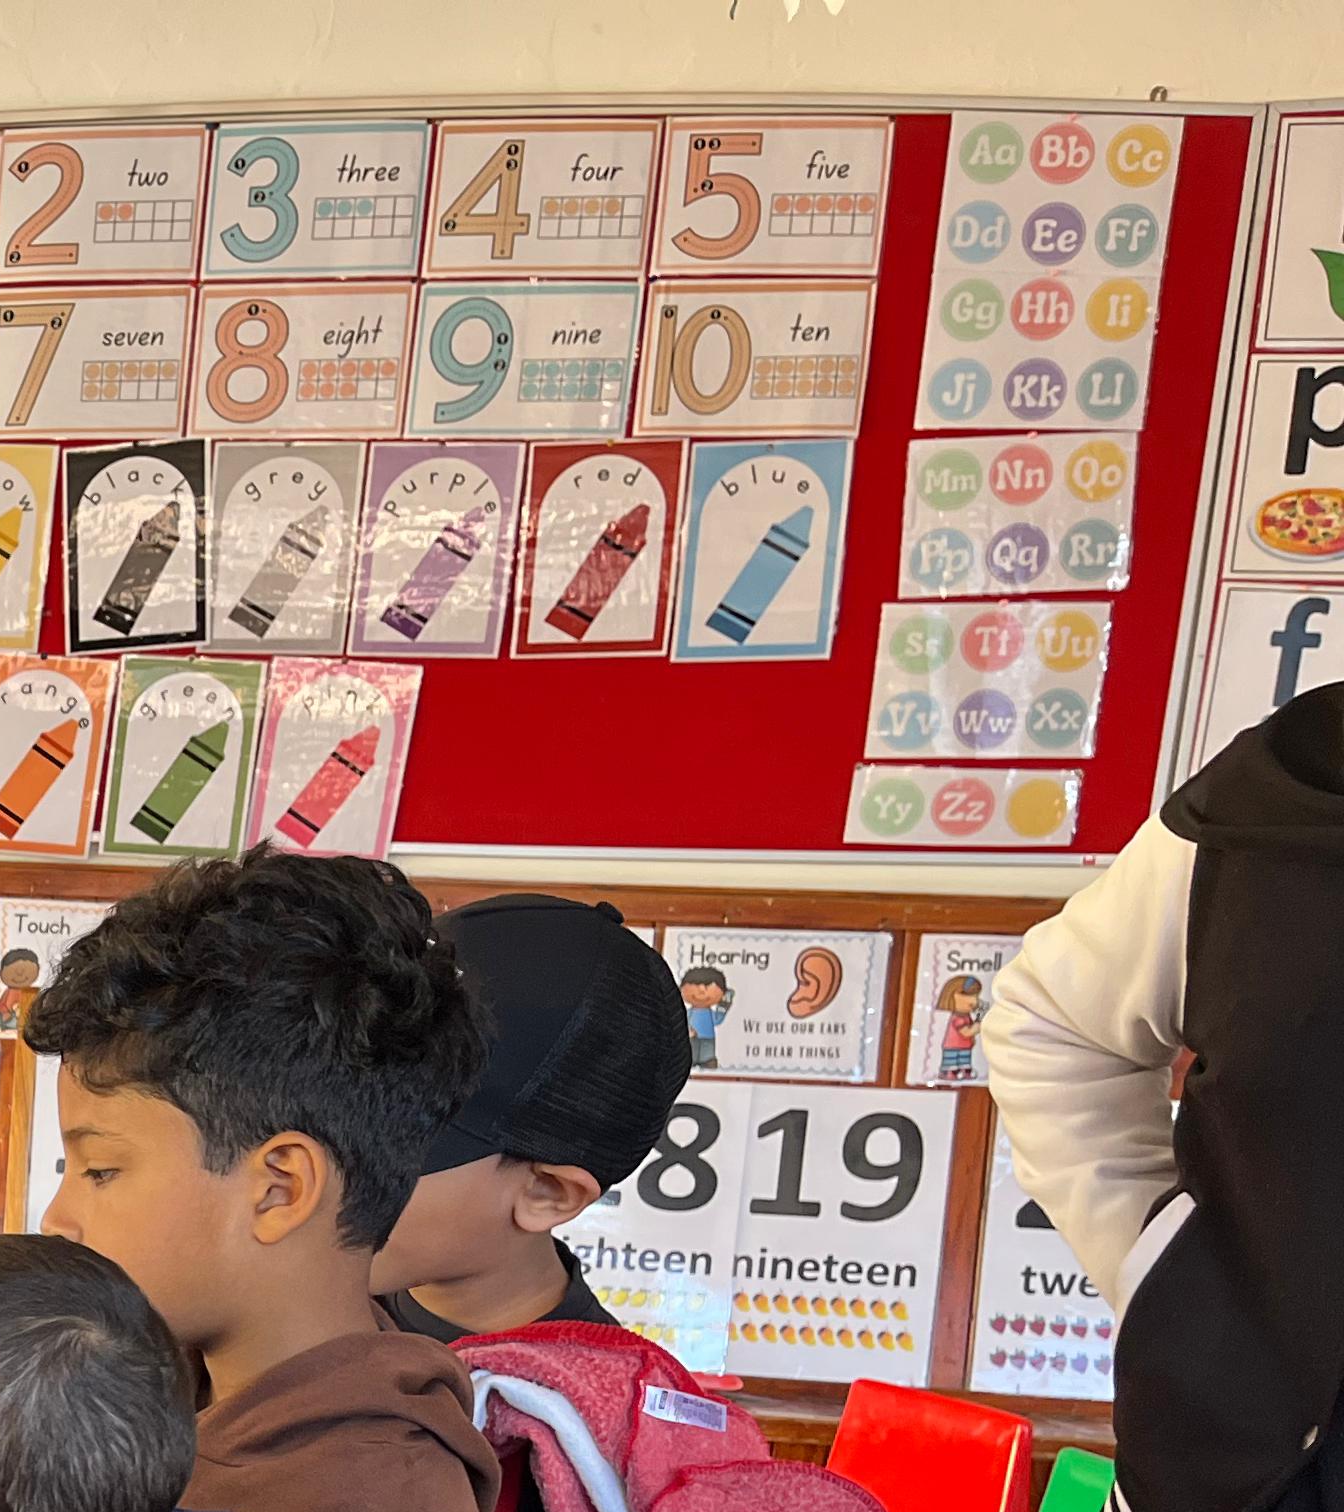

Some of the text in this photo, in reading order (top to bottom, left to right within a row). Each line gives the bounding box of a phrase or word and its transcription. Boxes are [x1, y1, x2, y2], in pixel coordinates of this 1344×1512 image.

[336, 154, 401, 184] three
[570, 153, 624, 184] four
[805, 148, 850, 181] five
[969, 134, 1164, 173] Aa Bb Cc
[128, 158, 169, 188] two
[5, 142, 84, 267] 2
[220, 137, 300, 263] 3
[439, 140, 531, 260] 4
[672, 133, 763, 261] 5
[952, 216, 1150, 254] Dd Ee Ff
[950, 292, 1133, 327] Gg Hh Ii
[102, 328, 165, 348] seven
[322, 315, 383, 358] eight
[551, 324, 603, 347] nine
[790, 313, 830, 343] ten
[205, 299, 290, 424] 8
[429, 297, 513, 424] 9
[650, 303, 752, 416] 10
[942, 372, 1124, 415] Jj Kk Ll
[1284, 366, 1344, 475] p
[84, 469, 187, 506] black
[244, 469, 328, 503] grey
[383, 469, 497, 518] purple
[573, 466, 643, 489] red
[720, 464, 811, 497] blue
[924, 468, 977, 494] Mm
[995, 459, 1046, 491] Nn
[919, 533, 1116, 577] Pp Qq Rr
[975, 626, 1011, 656] Tt
[1043, 626, 1093, 657] Uu
[139, 683, 236, 722] green
[886, 700, 1083, 736] Vv Ww Xx
[874, 791, 986, 824] Yy Zz
[14, 913, 71, 936] Touch
[690, 944, 770, 970] Hearing
[947, 950, 1002, 972] Smell
[749, 1108, 924, 1222] 19
[732, 1243, 917, 1288] nineteen
